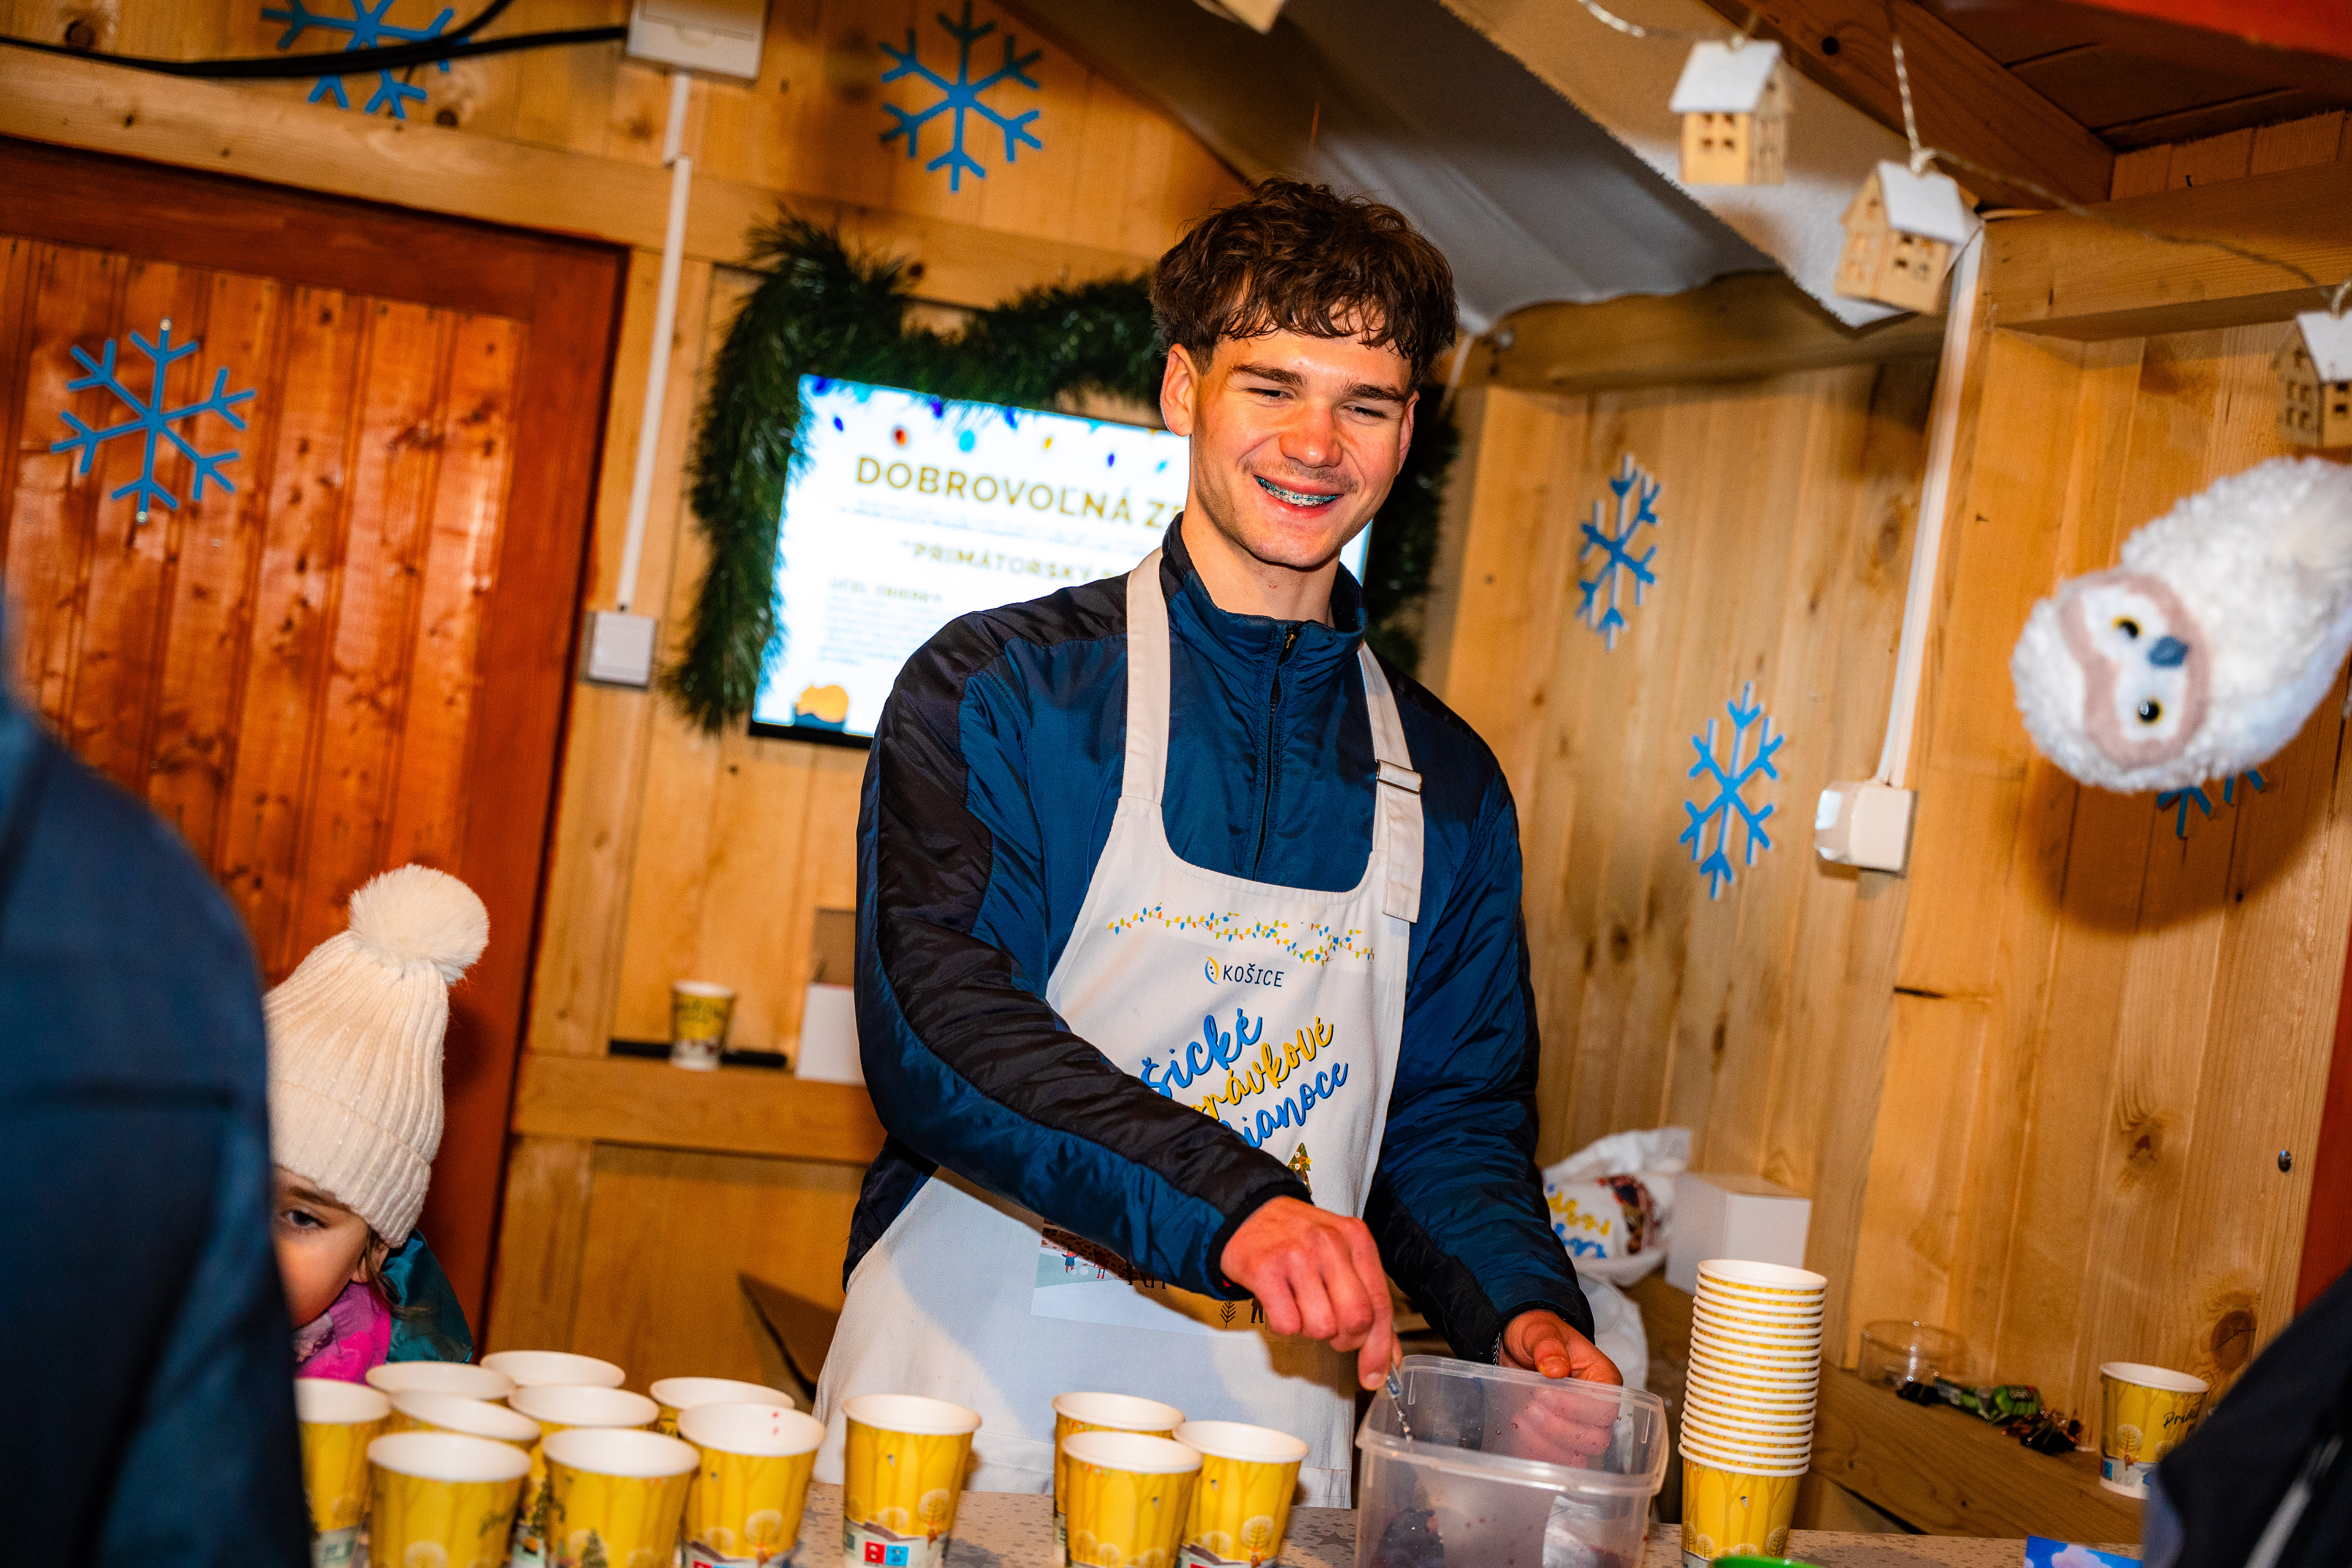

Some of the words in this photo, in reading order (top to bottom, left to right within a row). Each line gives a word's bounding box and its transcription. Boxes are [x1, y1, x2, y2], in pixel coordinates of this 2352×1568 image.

[857, 456, 1131, 523] DOBROVOĽNÁ
[1223, 962, 1284, 987] KOŠICE
[1140, 1007, 1263, 1099] šické
[1190, 1016, 1334, 1120] rávkové
[1220, 1062, 1348, 1149] ianoce
